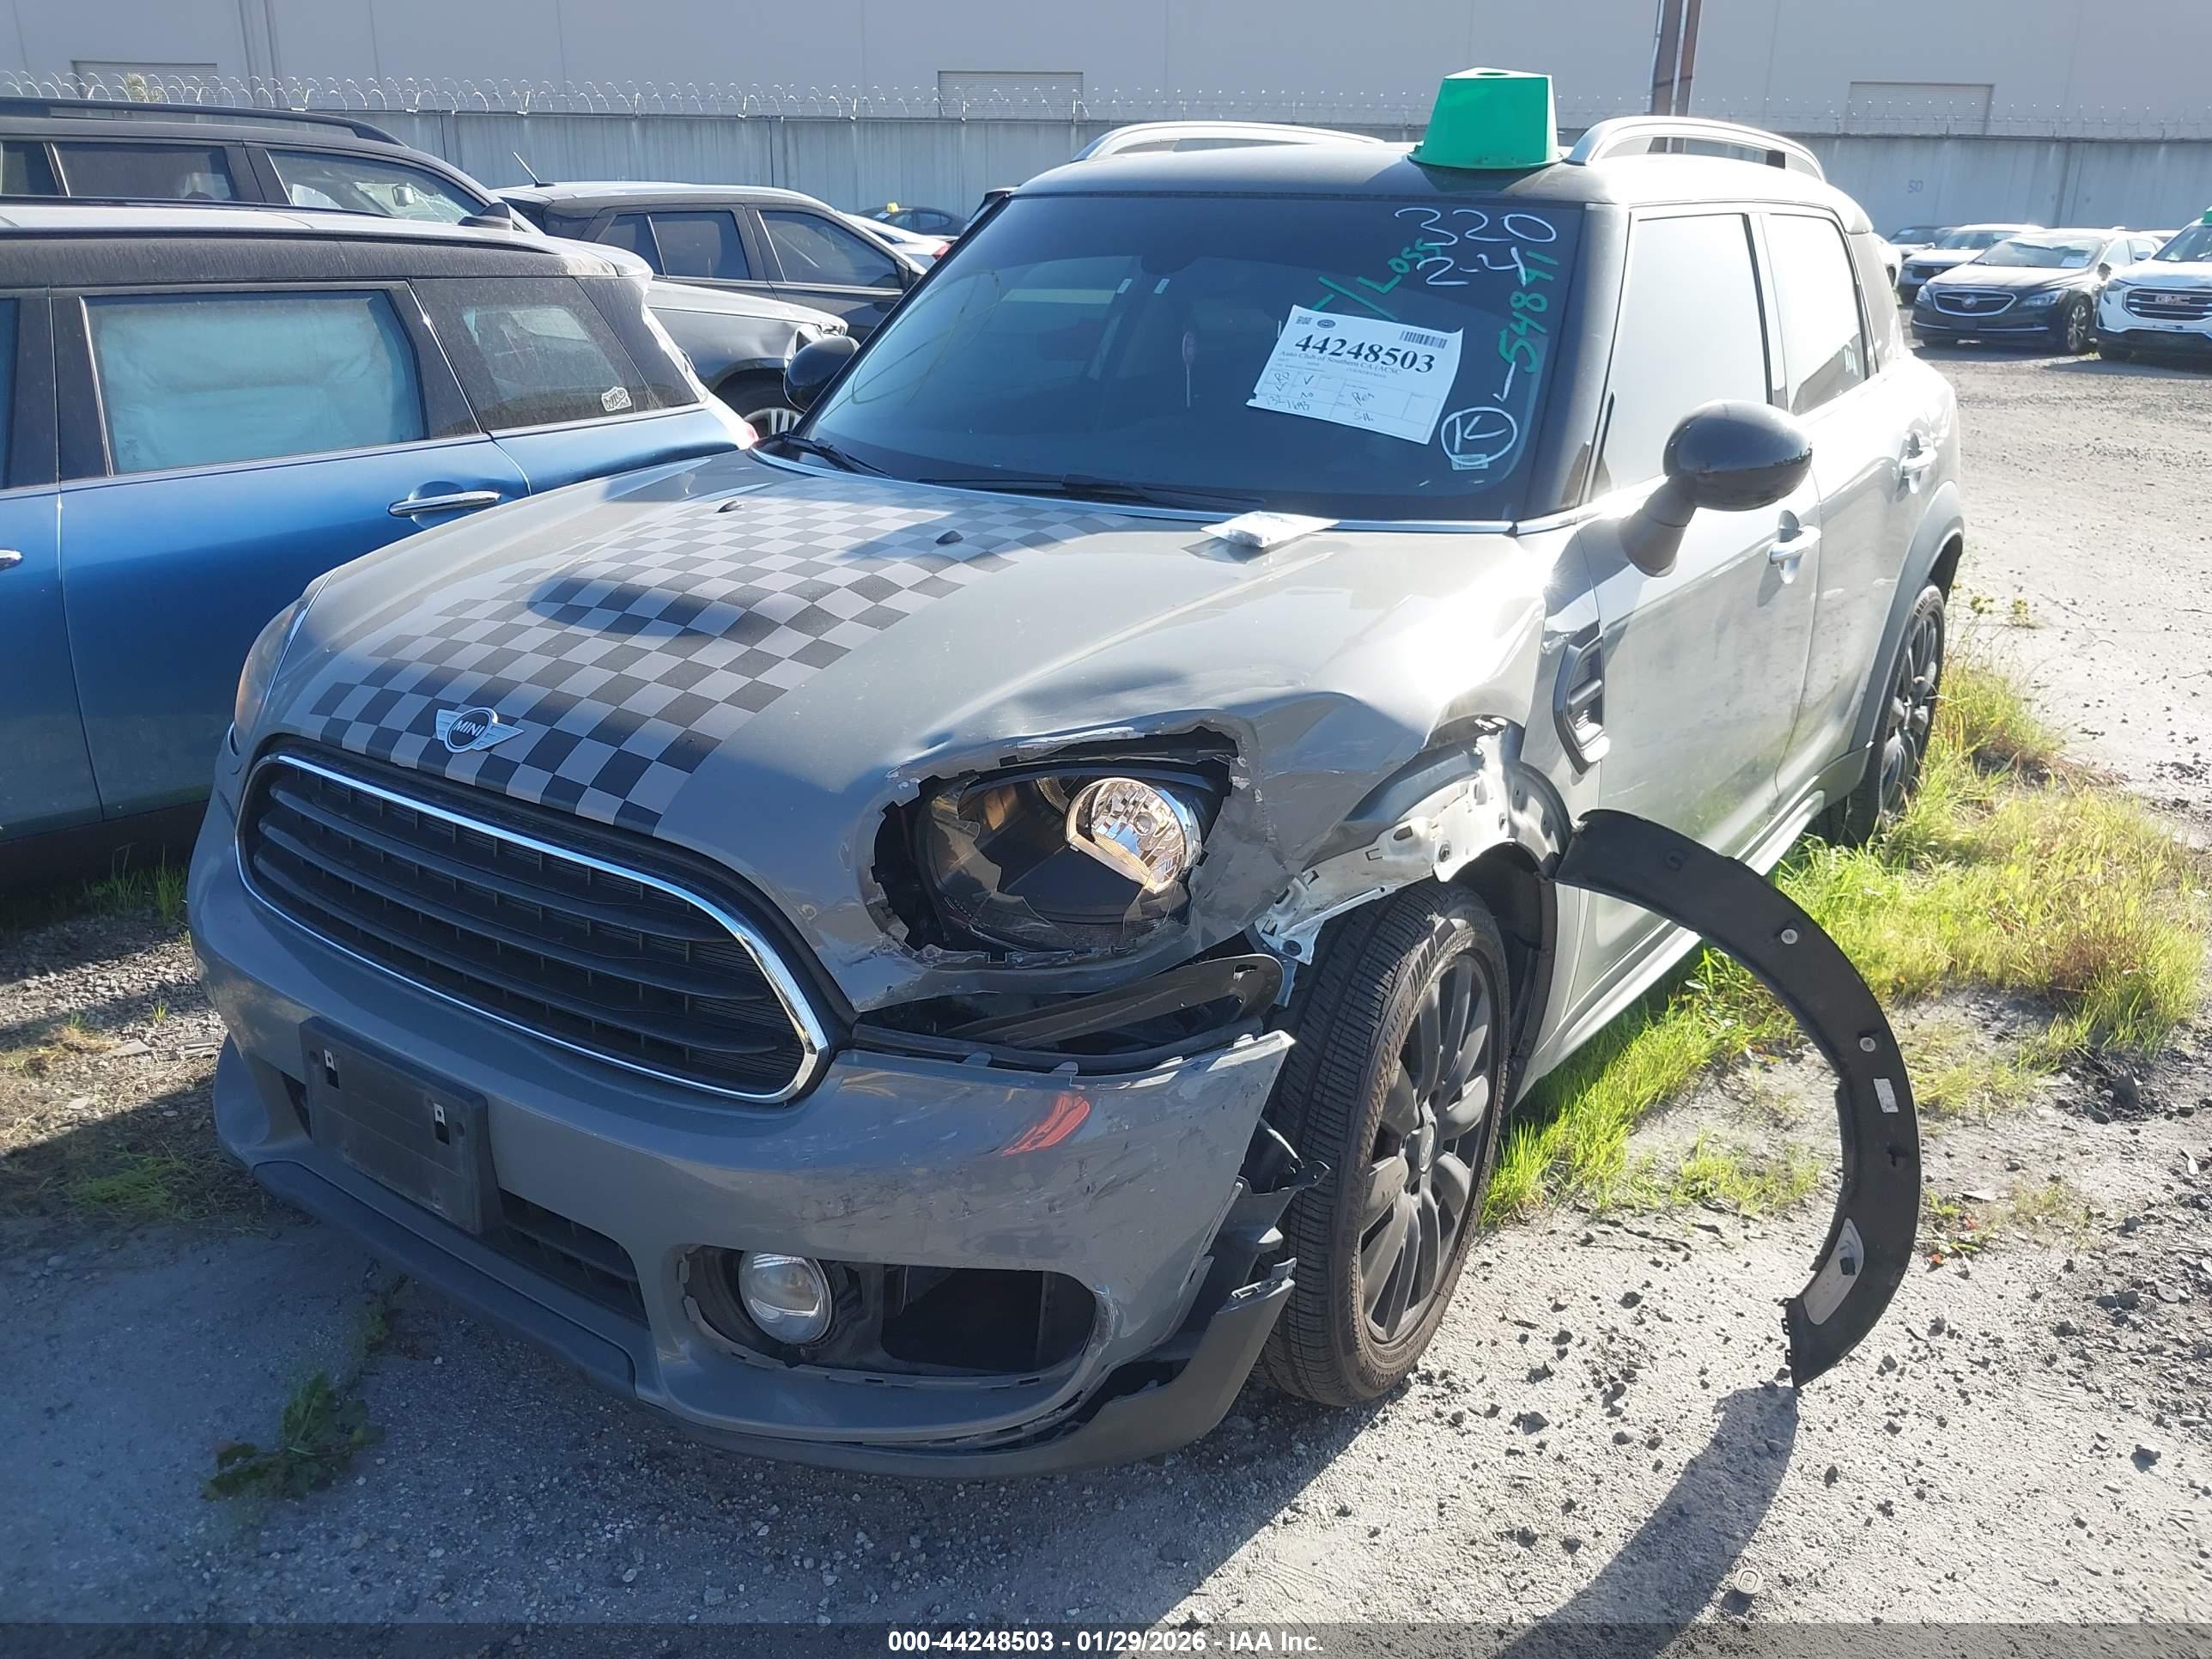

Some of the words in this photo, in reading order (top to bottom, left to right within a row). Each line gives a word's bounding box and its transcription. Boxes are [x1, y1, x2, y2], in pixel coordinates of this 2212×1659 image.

[1394, 207, 1558, 246] 320
[1416, 246, 1527, 288] 2-4
[1294, 333, 1436, 374] 44248503
[453, 720, 486, 737] MINI
